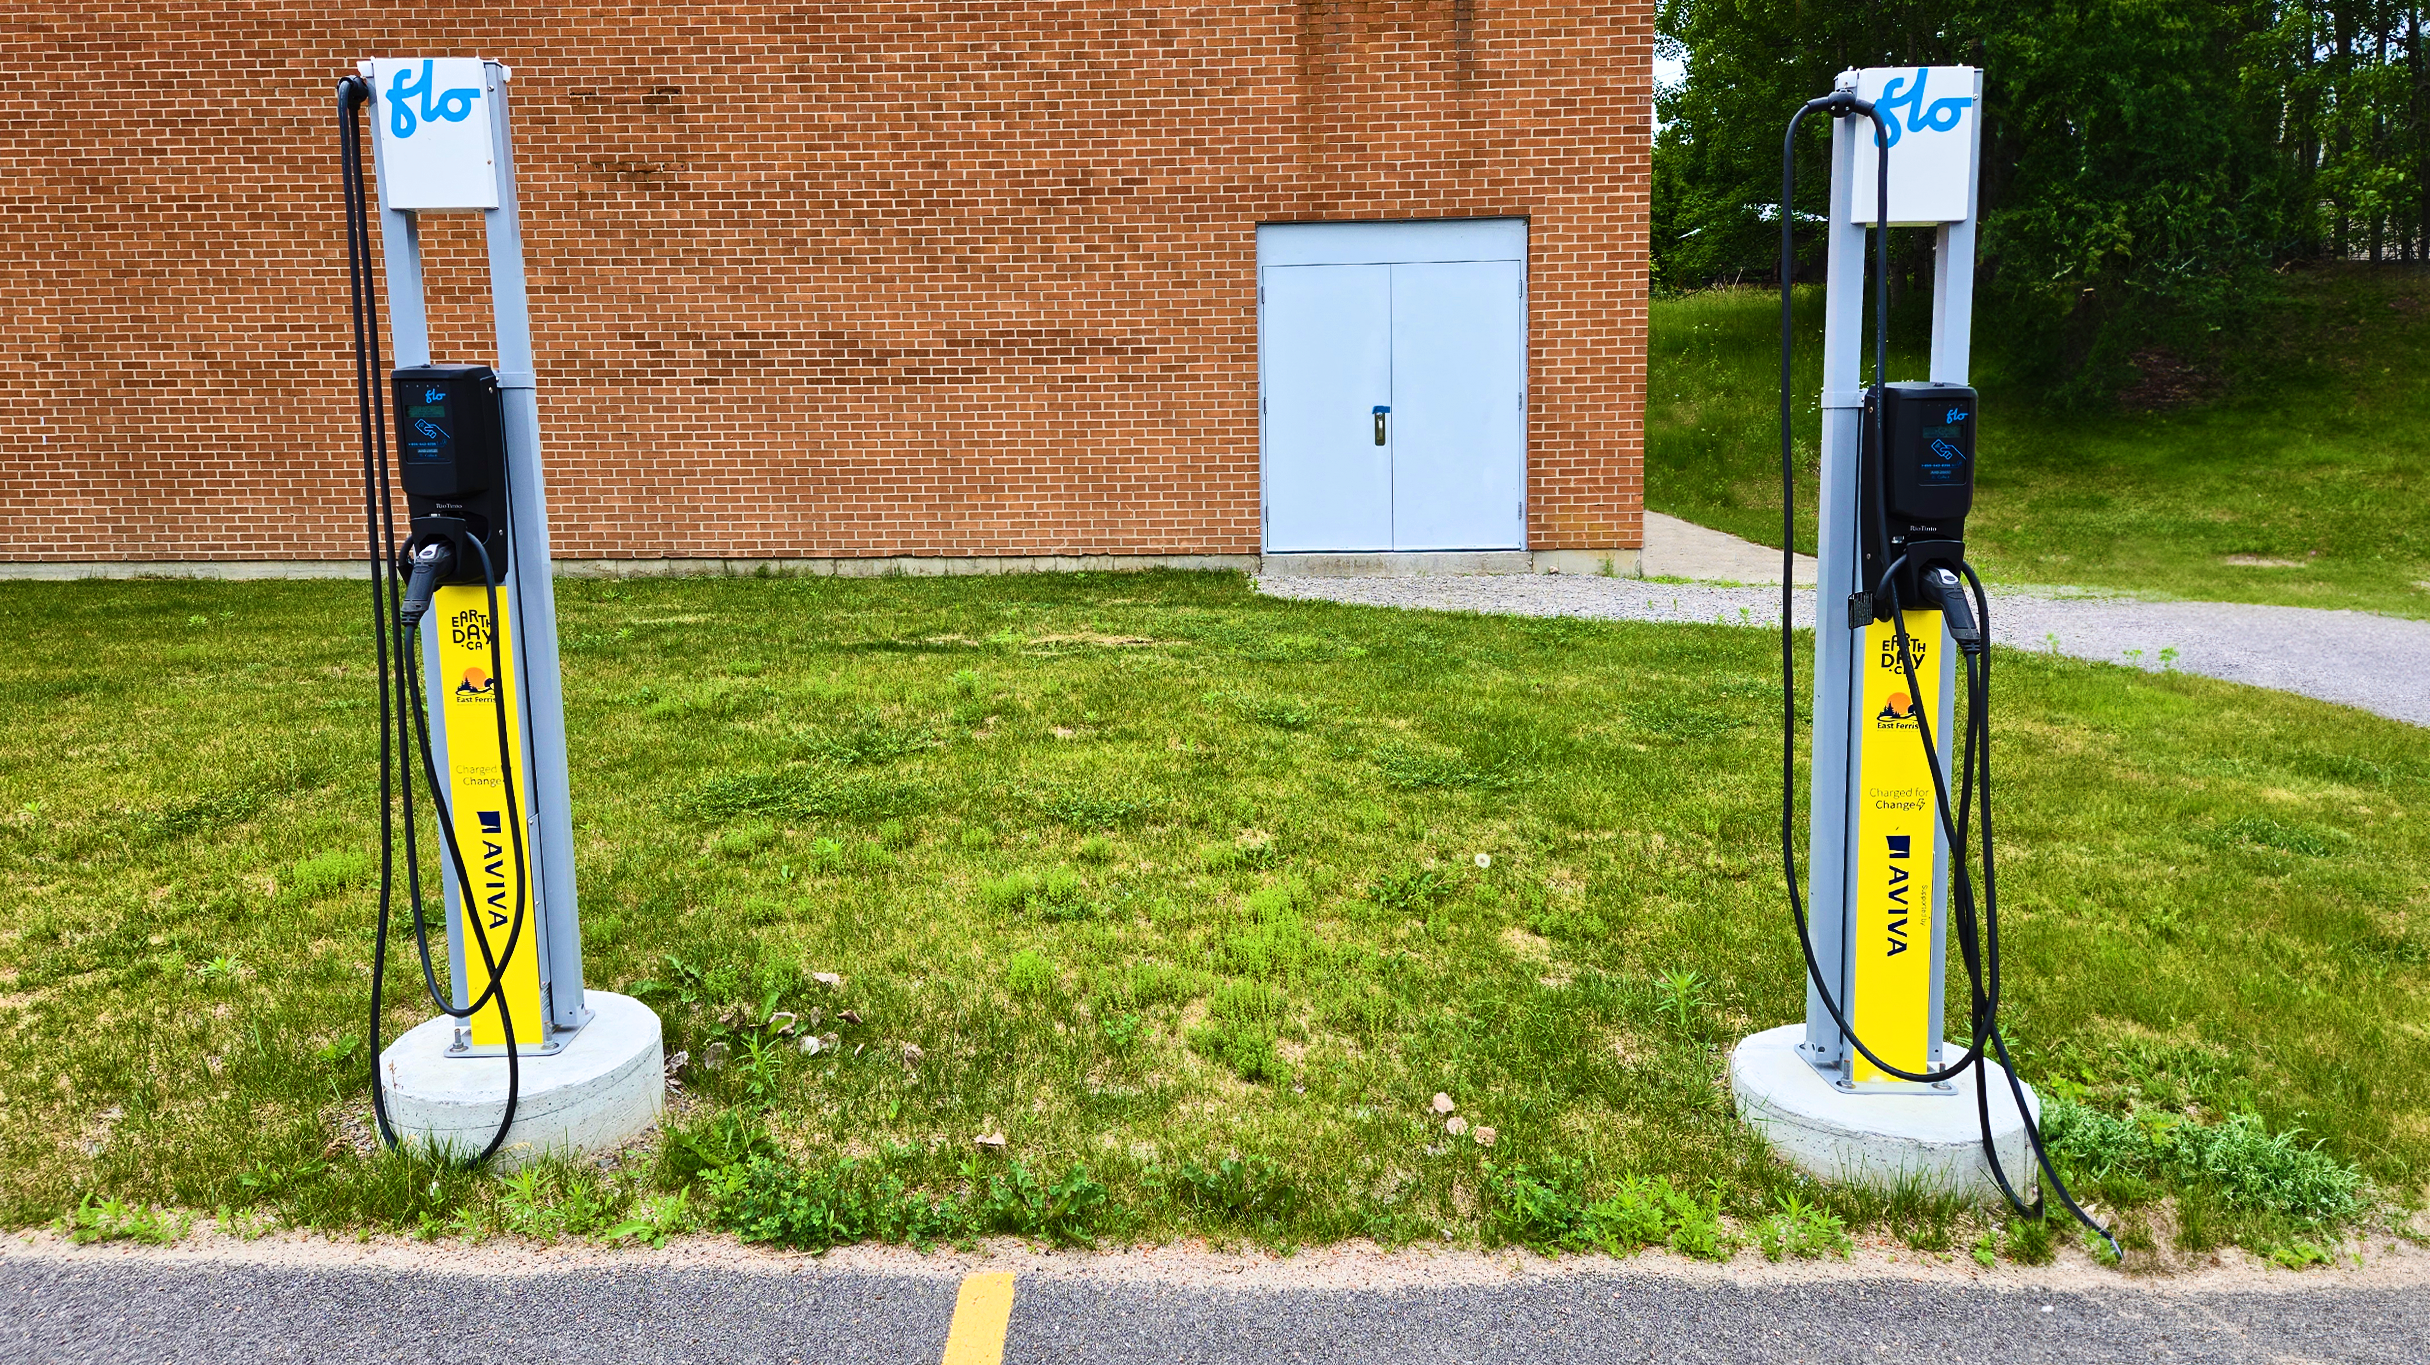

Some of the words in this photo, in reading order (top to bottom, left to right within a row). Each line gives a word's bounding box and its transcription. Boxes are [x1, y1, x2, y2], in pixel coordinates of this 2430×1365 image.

[385, 59, 481, 139] flo
[1873, 68, 1972, 149] flo
[425, 388, 446, 404] flo
[1946, 408, 1969, 424] flo
[1896, 721, 1919, 729] Ferris
[456, 764, 498, 776] Charged
[463, 776, 502, 788] Change
[1869, 787, 1913, 800] Charged
[1915, 787, 1930, 797] for
[1875, 799, 1916, 811] Change
[482, 840, 508, 930] AVIVA
[1887, 865, 1909, 957] AVIVA
